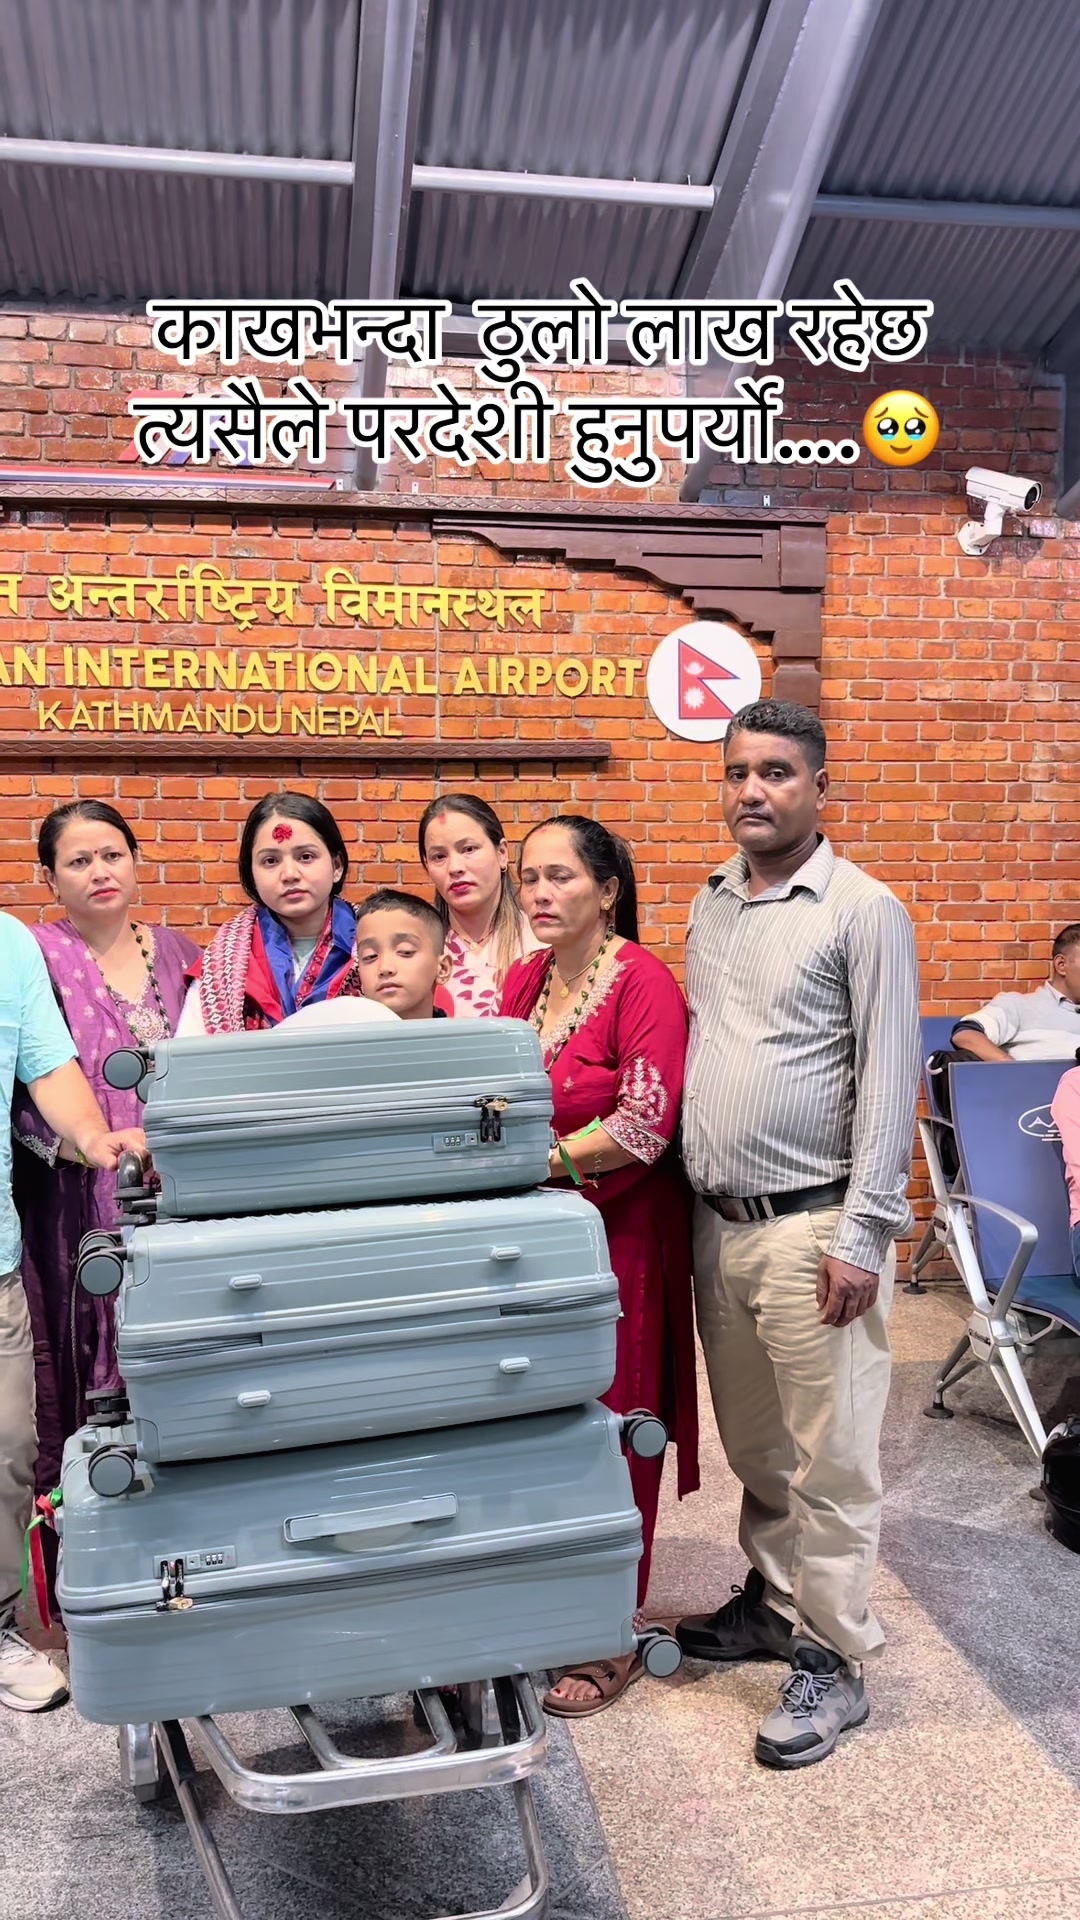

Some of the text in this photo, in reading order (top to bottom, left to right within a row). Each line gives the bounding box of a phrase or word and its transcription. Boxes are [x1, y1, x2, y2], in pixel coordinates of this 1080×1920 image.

[322, 566, 545, 629] विमानस्थल
[63, 646, 438, 694] INTERNATIONAL
[453, 657, 643, 697] AIRPORT
[38, 700, 403, 737] KATHMANDU NEPAL
